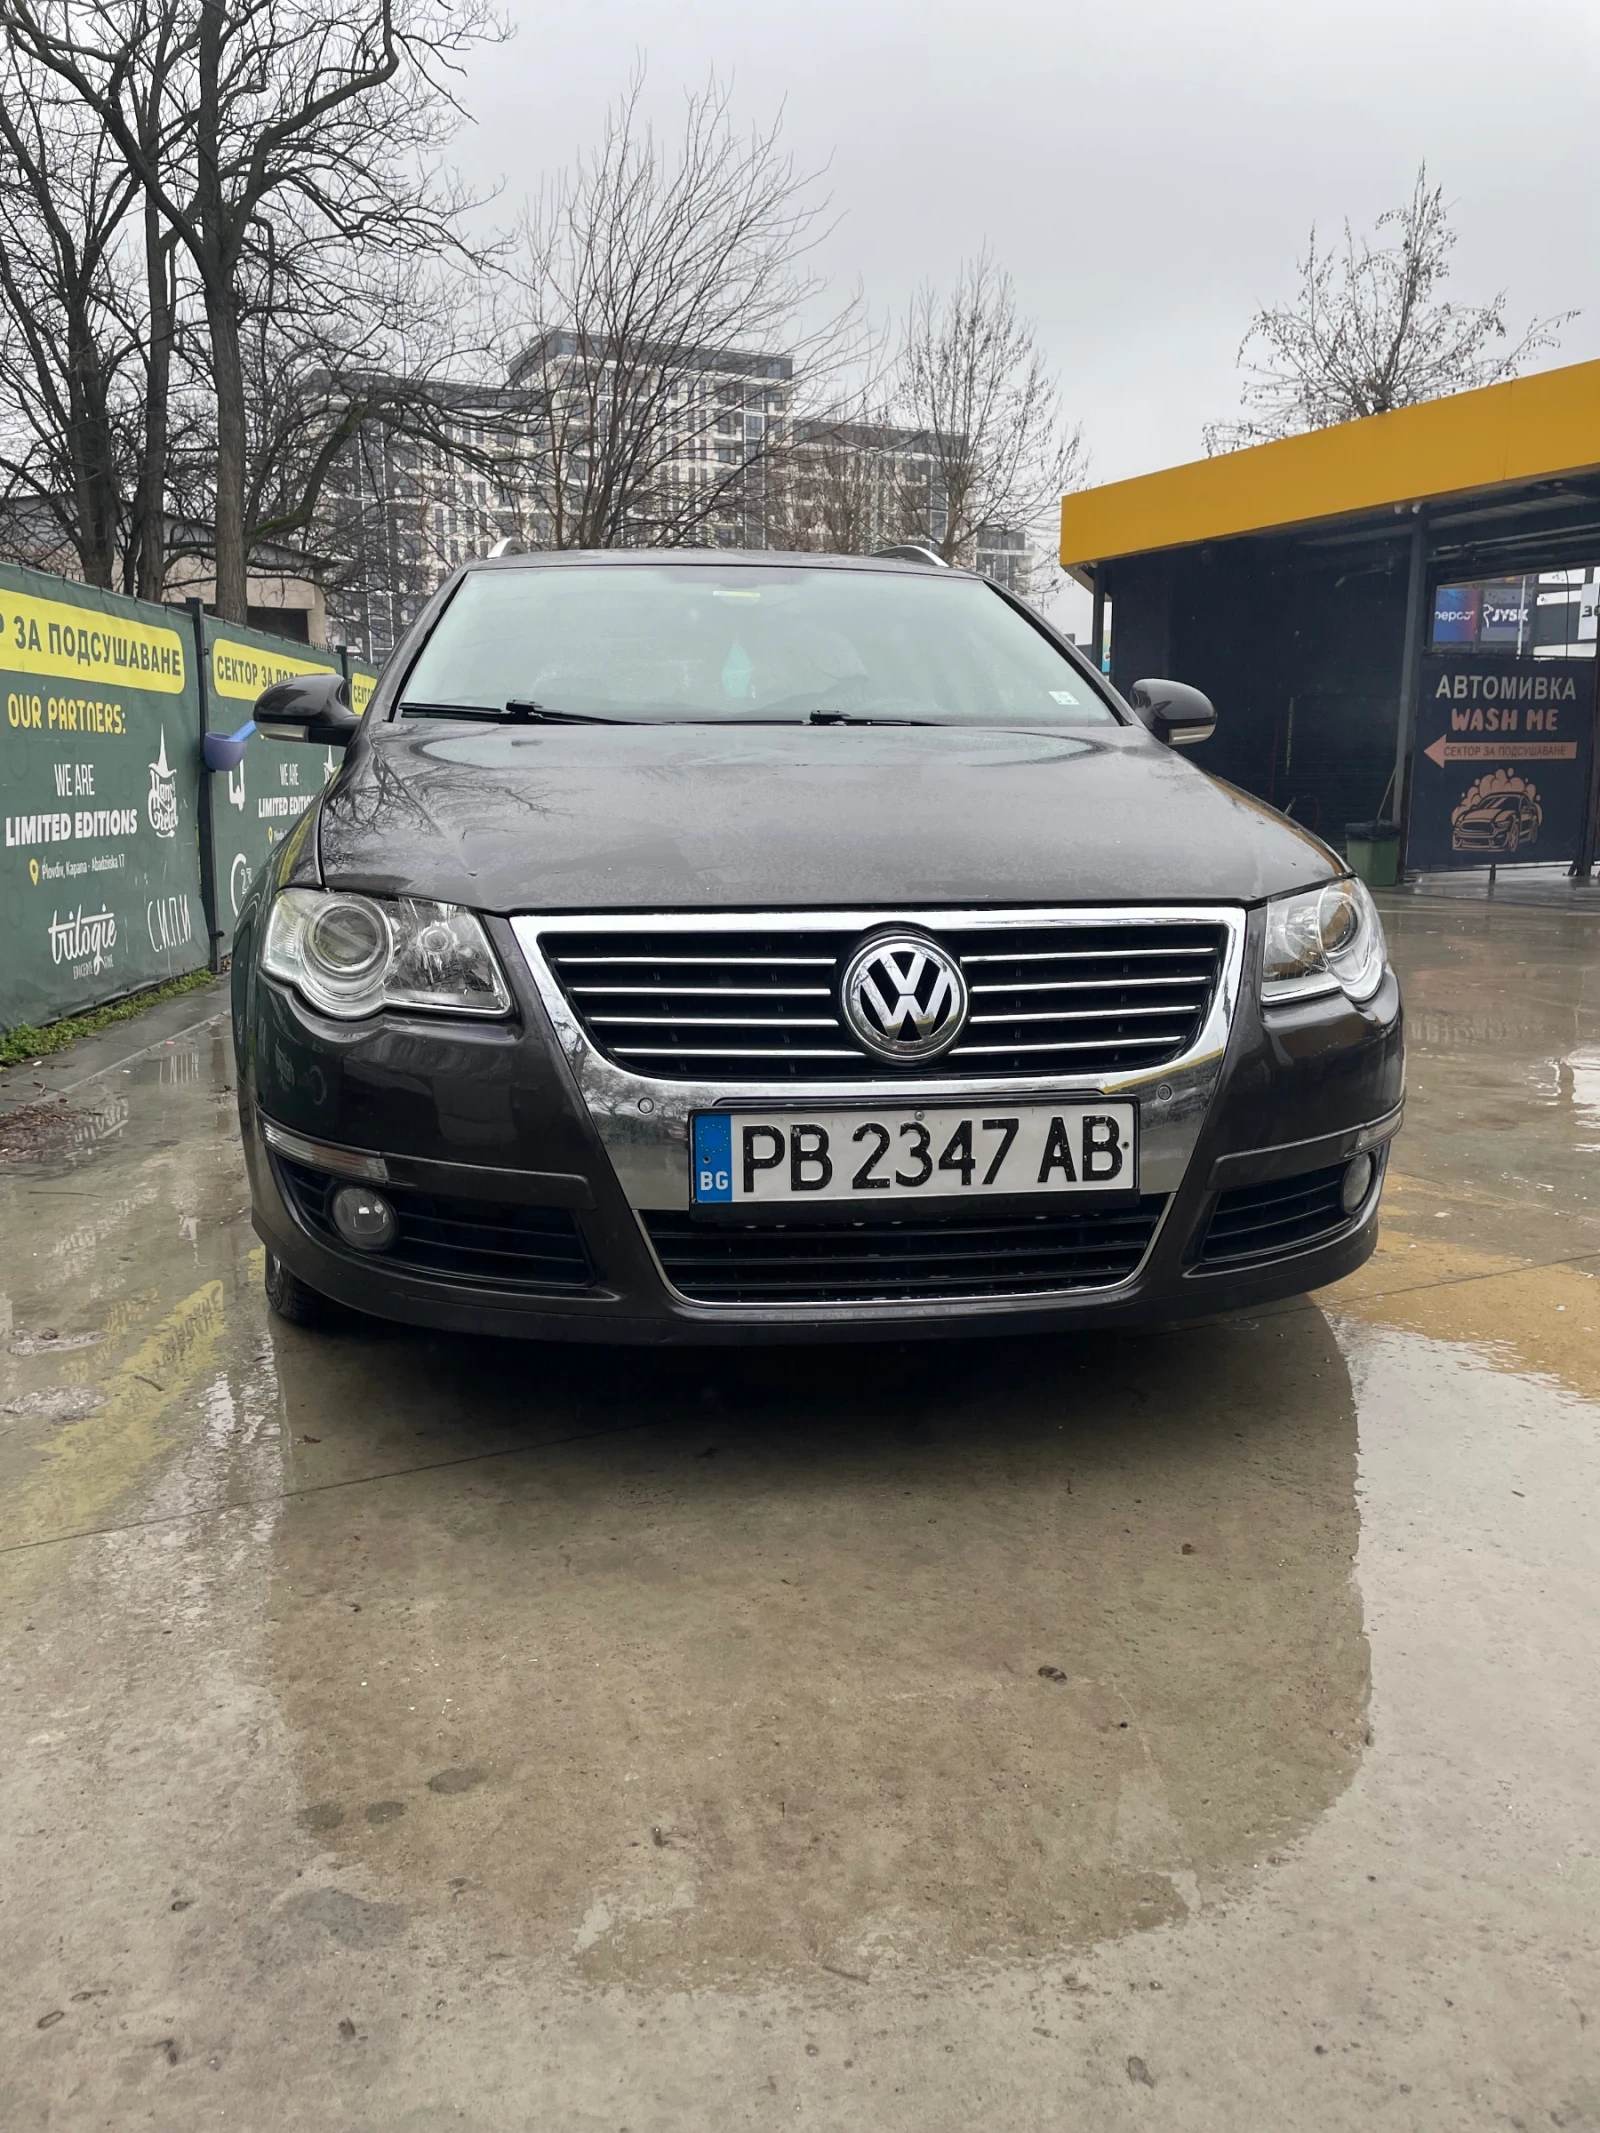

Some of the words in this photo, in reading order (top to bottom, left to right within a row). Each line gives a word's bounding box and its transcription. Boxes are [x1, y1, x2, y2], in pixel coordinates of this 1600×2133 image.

[1491, 608, 1529, 622] JYSK
[13, 615, 42, 653] ЗА
[48, 622, 182, 676] ПОДСУШАВАНЕ
[216, 656, 258, 686] СЕКТОР
[261, 666, 273, 688] ЗА
[1435, 675, 1577, 700] АВТОМИВКА
[8, 693, 42, 729] OUR
[48, 697, 126, 734] PARTNERS:
[1451, 708, 1518, 731] WASH
[1526, 708, 1559, 731] ME
[1444, 745, 1481, 757] СЕКТОР
[1483, 745, 1496, 757] ЗА
[1499, 745, 1566, 758] ПОДСУШАВАНЕ
[54, 764, 73, 797] WE
[75, 764, 95, 796] ARE
[279, 763, 289, 786] WE
[289, 763, 299, 786] ARE
[258, 797, 288, 818] LIMITED
[5, 813, 72, 847] LIMITED
[75, 809, 138, 839] EDITIONS
[66, 860, 87, 878] Kapana
[118, 853, 125, 868] 17
[48, 903, 118, 976] trilogie
[742, 1123, 834, 1193] PB
[852, 1117, 1020, 1190] 2347
[1037, 1115, 1123, 1183] AB
[700, 1171, 729, 1192] BG
